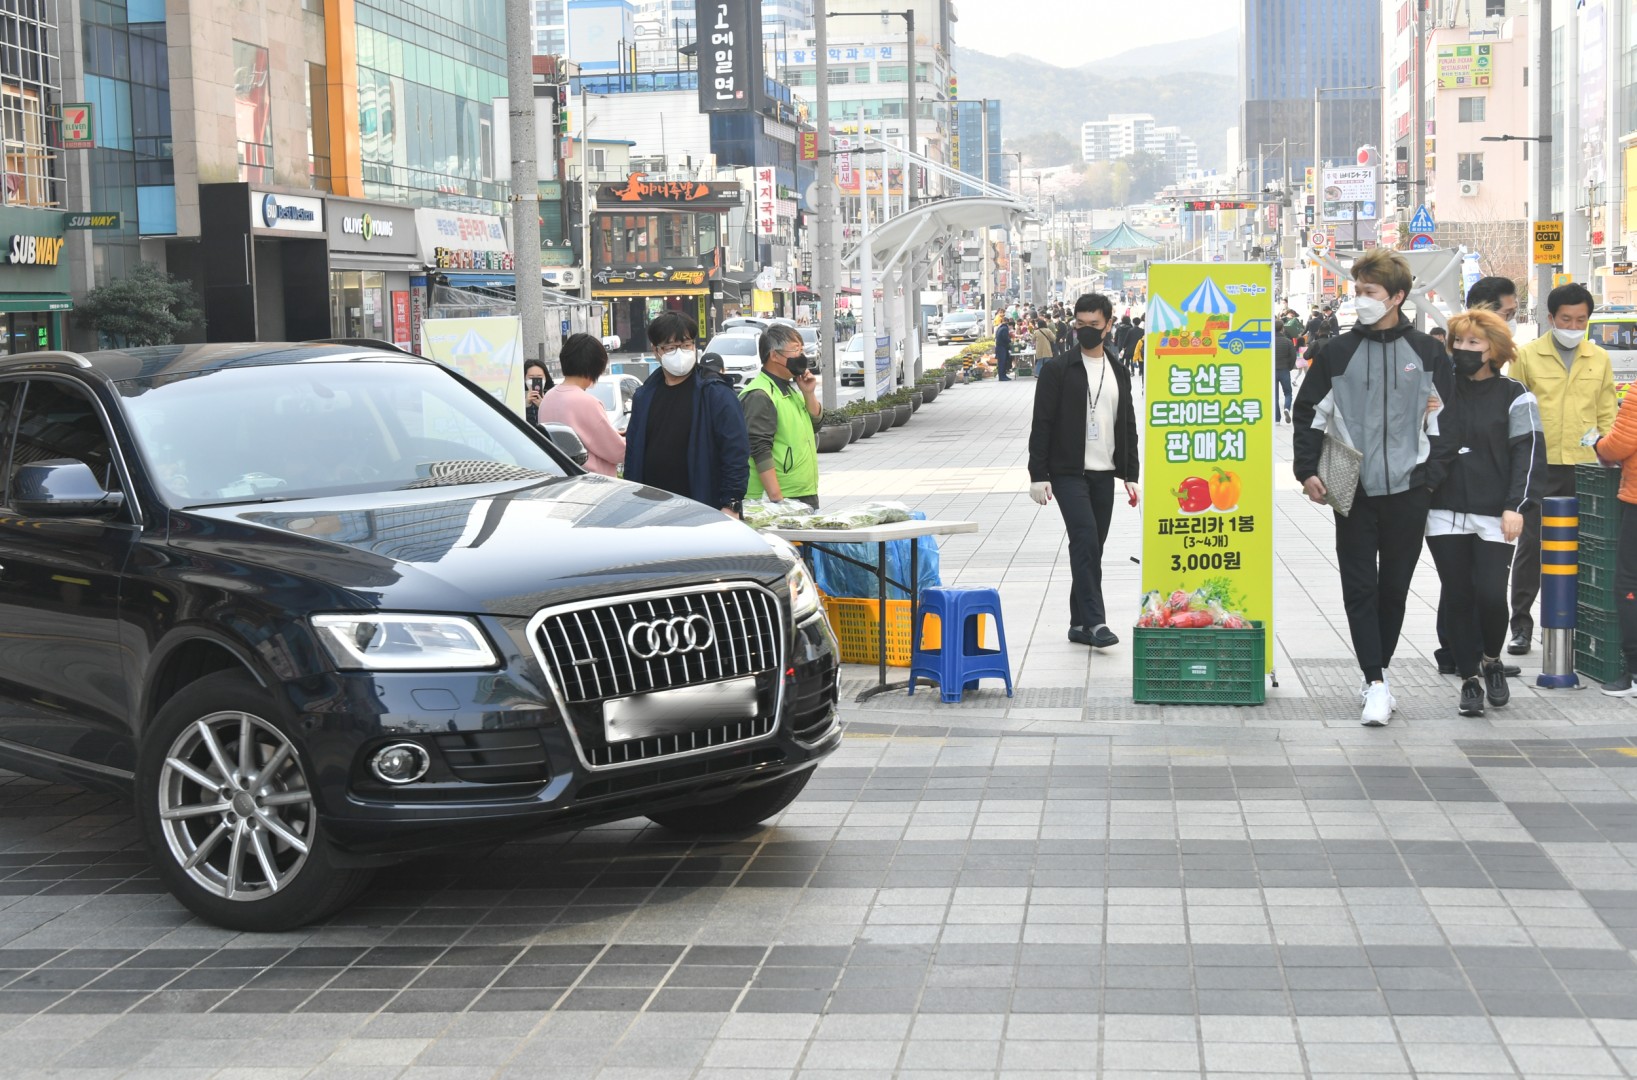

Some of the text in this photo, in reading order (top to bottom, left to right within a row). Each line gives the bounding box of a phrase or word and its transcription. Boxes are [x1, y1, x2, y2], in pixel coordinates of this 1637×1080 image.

[804, 133, 815, 159] BAR
[759, 169, 775, 234] 돼지국밥
[68, 215, 117, 228] SUBWAY
[343, 216, 393, 237] OLIVE YOUNG
[1536, 233, 1559, 241] CCTV
[10, 234, 65, 266] SUBWAY
[1169, 364, 1242, 395] 농산물
[1150, 400, 1262, 426] 드라이브 스루
[1165, 430, 1246, 462] 판매처
[1157, 515, 1255, 536] 파프리카 1봉
[1183, 535, 1229, 549] (3~4개)
[1170, 551, 1242, 574] 3,000원
